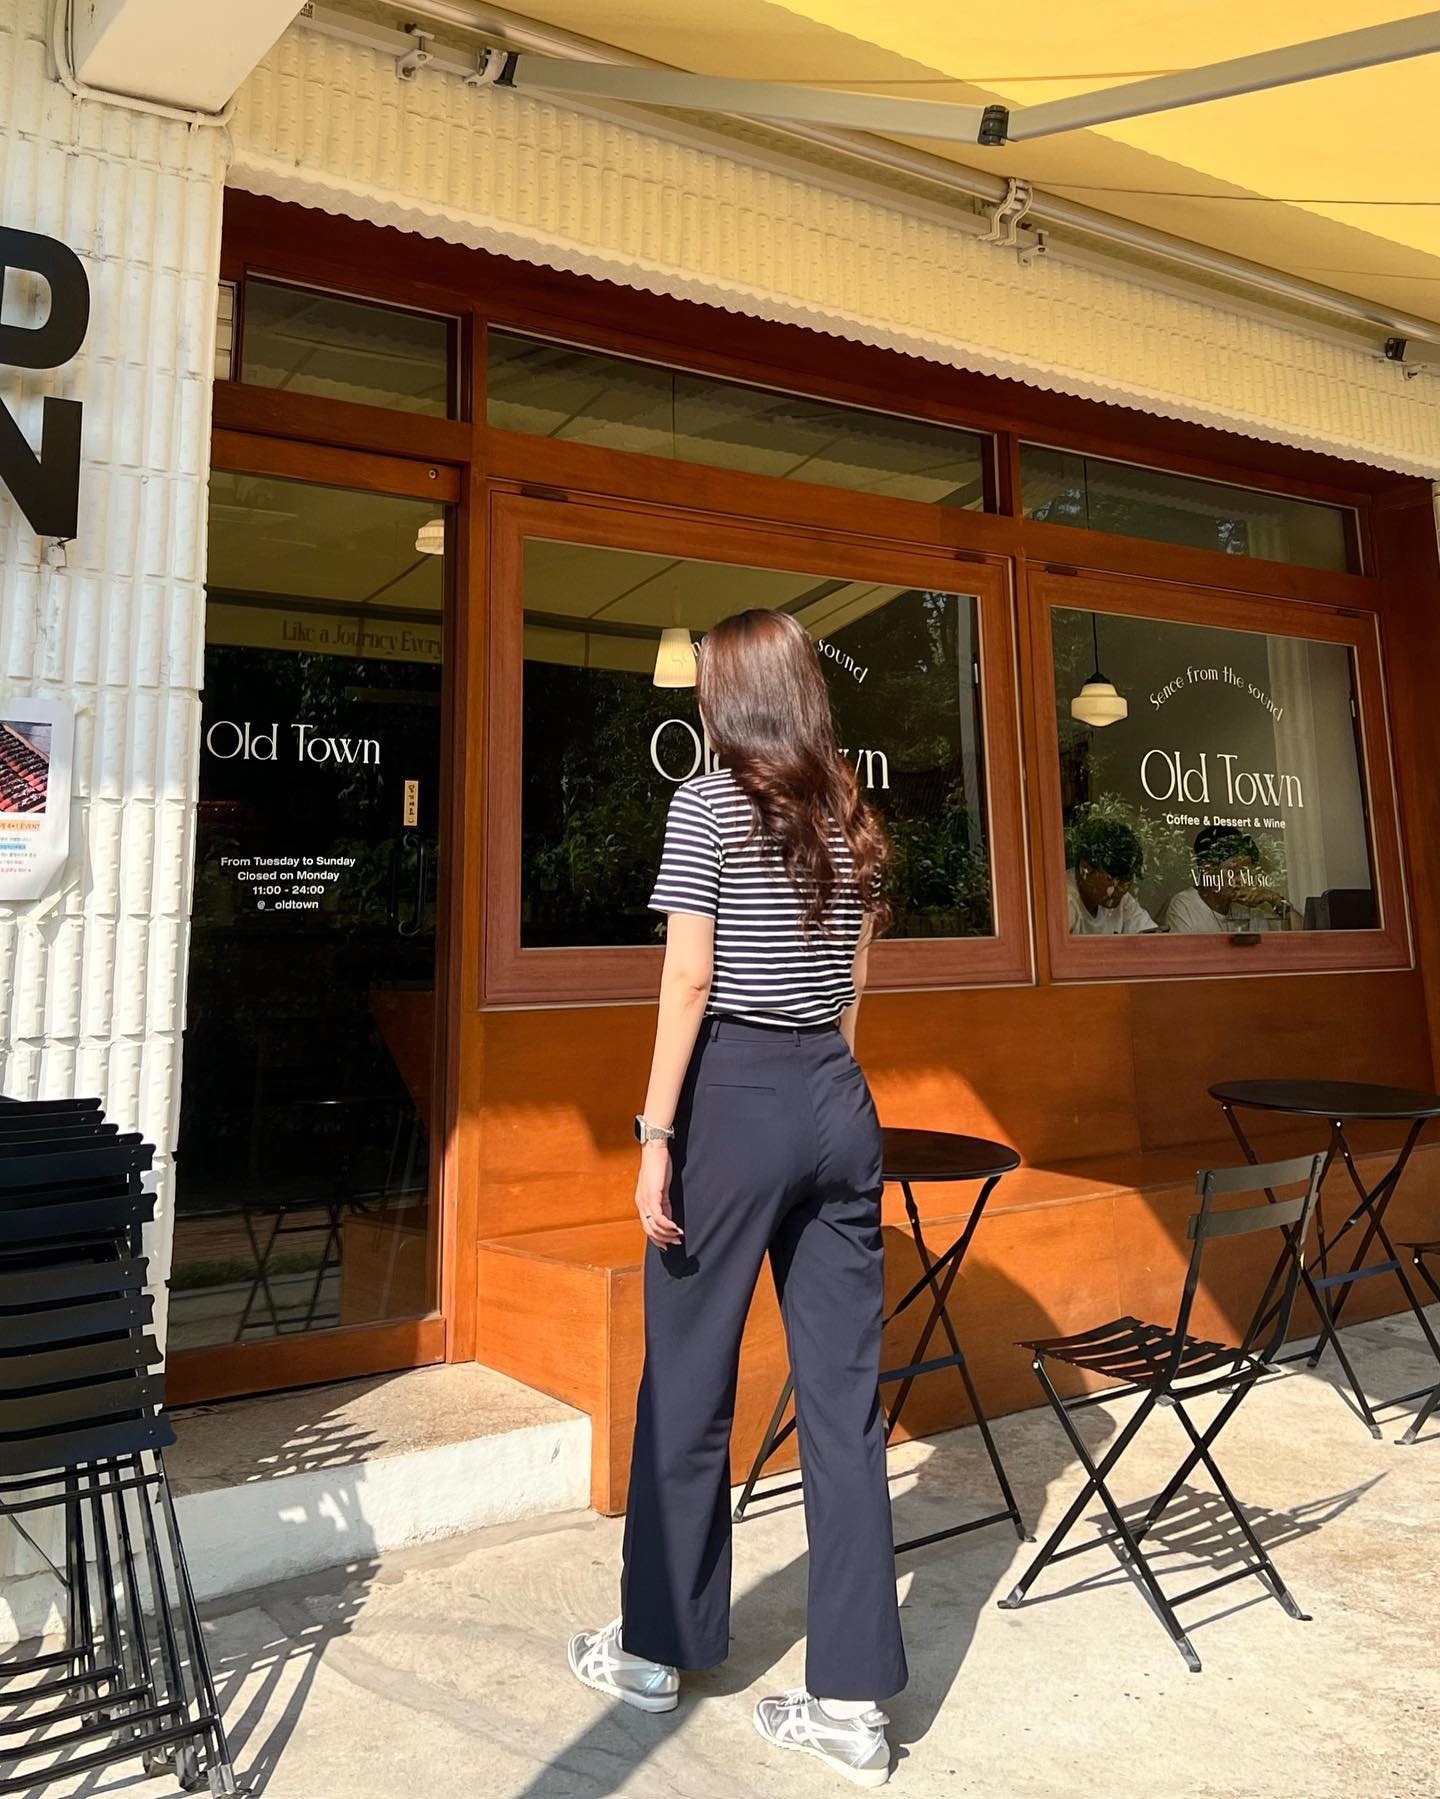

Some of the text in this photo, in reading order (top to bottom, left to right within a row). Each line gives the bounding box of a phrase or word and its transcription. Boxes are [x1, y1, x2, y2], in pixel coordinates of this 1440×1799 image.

[281, 619, 314, 641] Like
[320, 627, 329, 644] a
[332, 623, 397, 655] Journey
[817, 638, 869, 684] sound
[1149, 665, 1284, 722] Sence from the sound
[206, 720, 381, 764] Old Town
[650, 719, 720, 782] Ol
[1140, 749, 1304, 808] Old Town
[1166, 813, 1286, 829] Coffee & Dessert & Wine
[220, 856, 356, 868] From Tuesday to Sunday
[237, 870, 340, 882] Closed on Monday
[1190, 867, 1273, 893] Vinyl & Music
[253, 886, 282, 895] 11:00
[292, 885, 325, 894] 24:00
